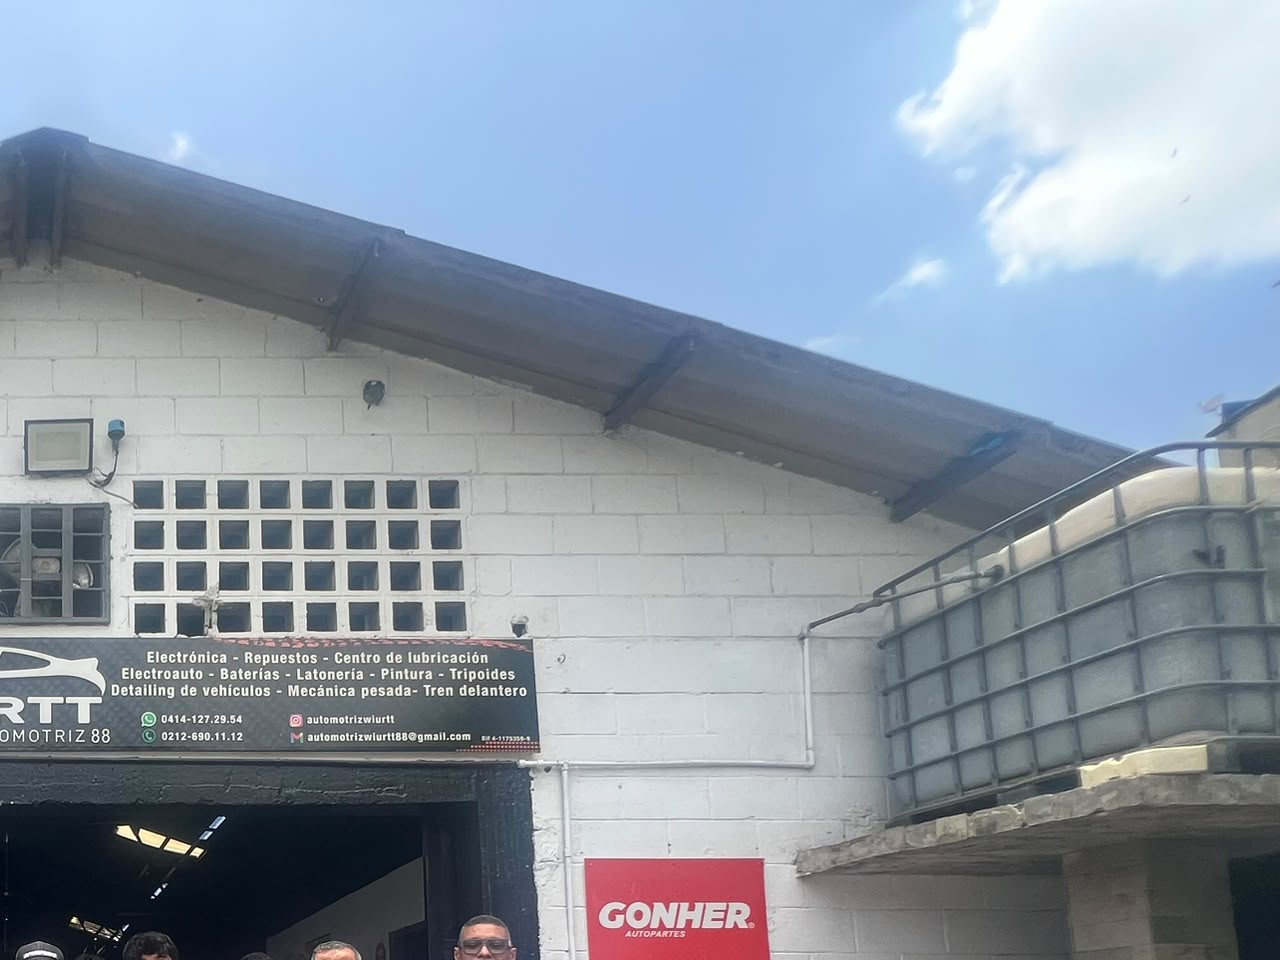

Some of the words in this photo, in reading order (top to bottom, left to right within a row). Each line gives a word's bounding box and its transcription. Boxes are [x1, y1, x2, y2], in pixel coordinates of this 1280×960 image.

[146, 651, 227, 664] Electrónica
[244, 652, 317, 666] Repuestos
[334, 652, 381, 664] Centro
[386, 652, 403, 664] de
[408, 651, 489, 664] lubricación
[122, 668, 203, 680] Electroauto
[221, 668, 280, 681] Baterías
[297, 668, 364, 680] Latonería
[381, 668, 433, 680] Pintura
[449, 668, 516, 682] Tripoides
[111, 684, 175, 699] Detailing
[180, 684, 197, 697] de
[202, 684, 271, 697] vehículos
[288, 684, 356, 697] Mecánica
[423, 684, 454, 697] Tren
[459, 684, 528, 697] delantero
[161, 715, 243, 724] 0414-127.29.54
[307, 715, 395, 724] automotrizwiurtt
[91, 728, 111, 744] 88
[161, 732, 243, 741] 0212-690.11.12
[307, 732, 471, 743] automotrizwiurtt88@gmail.com
[598, 901, 751, 929] GONHER
[624, 930, 686, 938] AUTOPARTES
